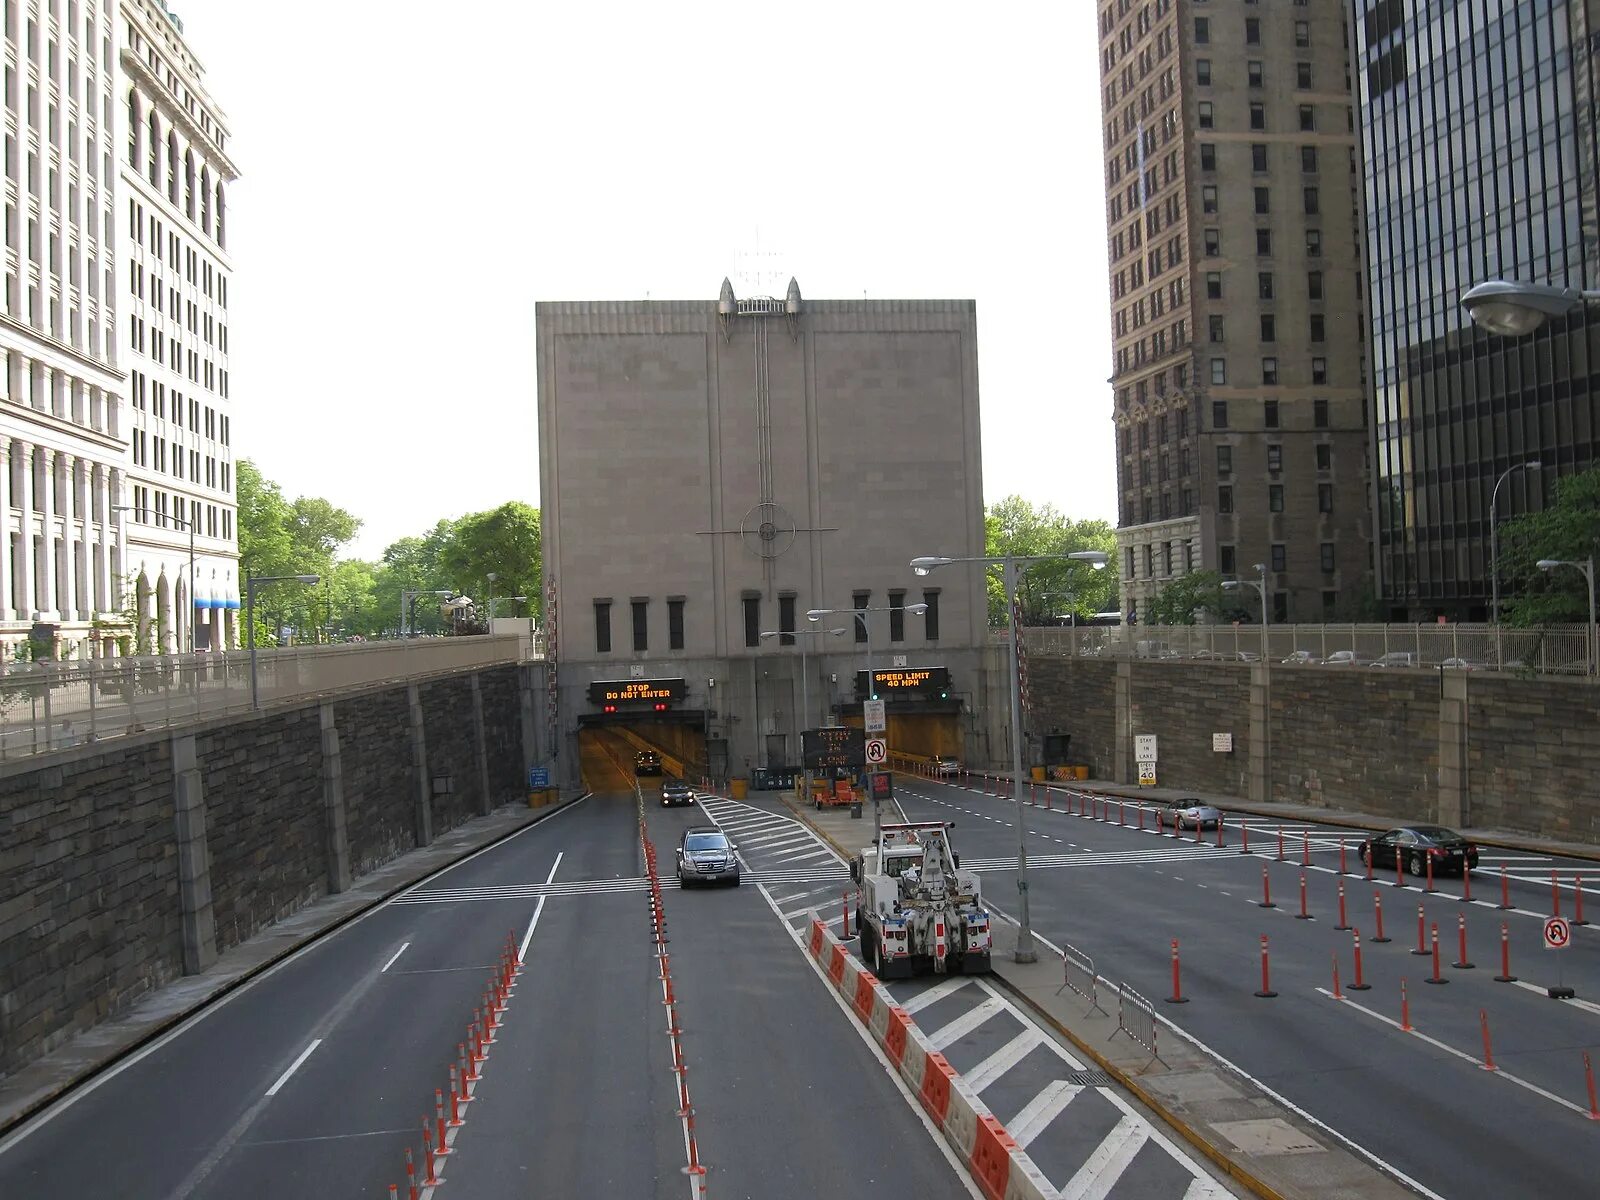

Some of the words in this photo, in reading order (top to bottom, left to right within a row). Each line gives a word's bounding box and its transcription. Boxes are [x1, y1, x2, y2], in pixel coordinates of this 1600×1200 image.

[876, 673, 903, 681] SPEED
[906, 672, 929, 680] LIMIT
[902, 679, 919, 687] MPH
[626, 684, 650, 692] STOP
[621, 691, 638, 699] NOT
[641, 690, 670, 698] ENTER
